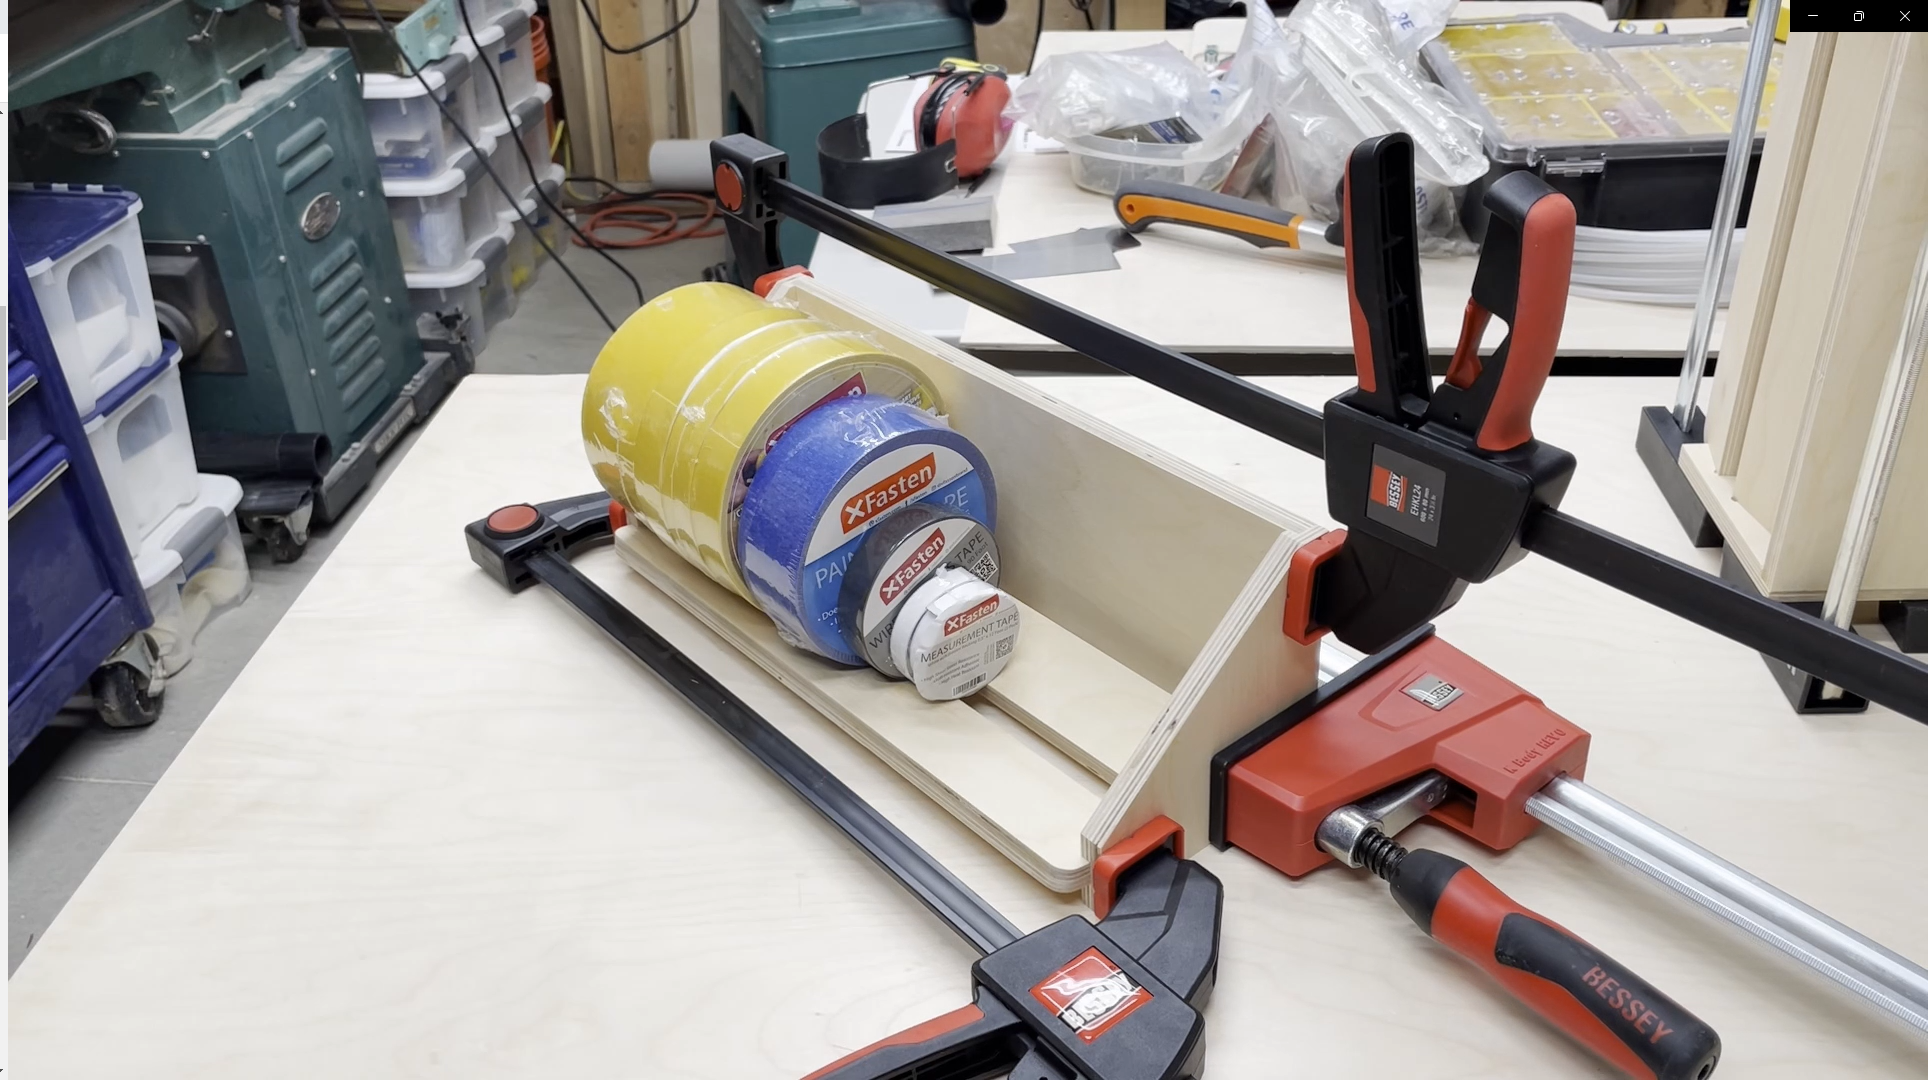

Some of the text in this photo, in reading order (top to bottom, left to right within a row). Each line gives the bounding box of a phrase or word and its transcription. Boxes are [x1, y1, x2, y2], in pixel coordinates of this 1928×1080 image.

[845, 465, 932, 525] XFasten
[944, 486, 968, 508] PE
[1389, 473, 1401, 508] BESSEY
[1410, 484, 1421, 516] EHKL24
[869, 616, 897, 648] WIR
[954, 531, 985, 563] TAPE
[882, 536, 944, 599] XFasten
[921, 623, 995, 663] MEASUREMENT
[996, 611, 1019, 629] TAPE
[948, 601, 997, 632] XFasten
[1581, 965, 1675, 1043] BESSEY
